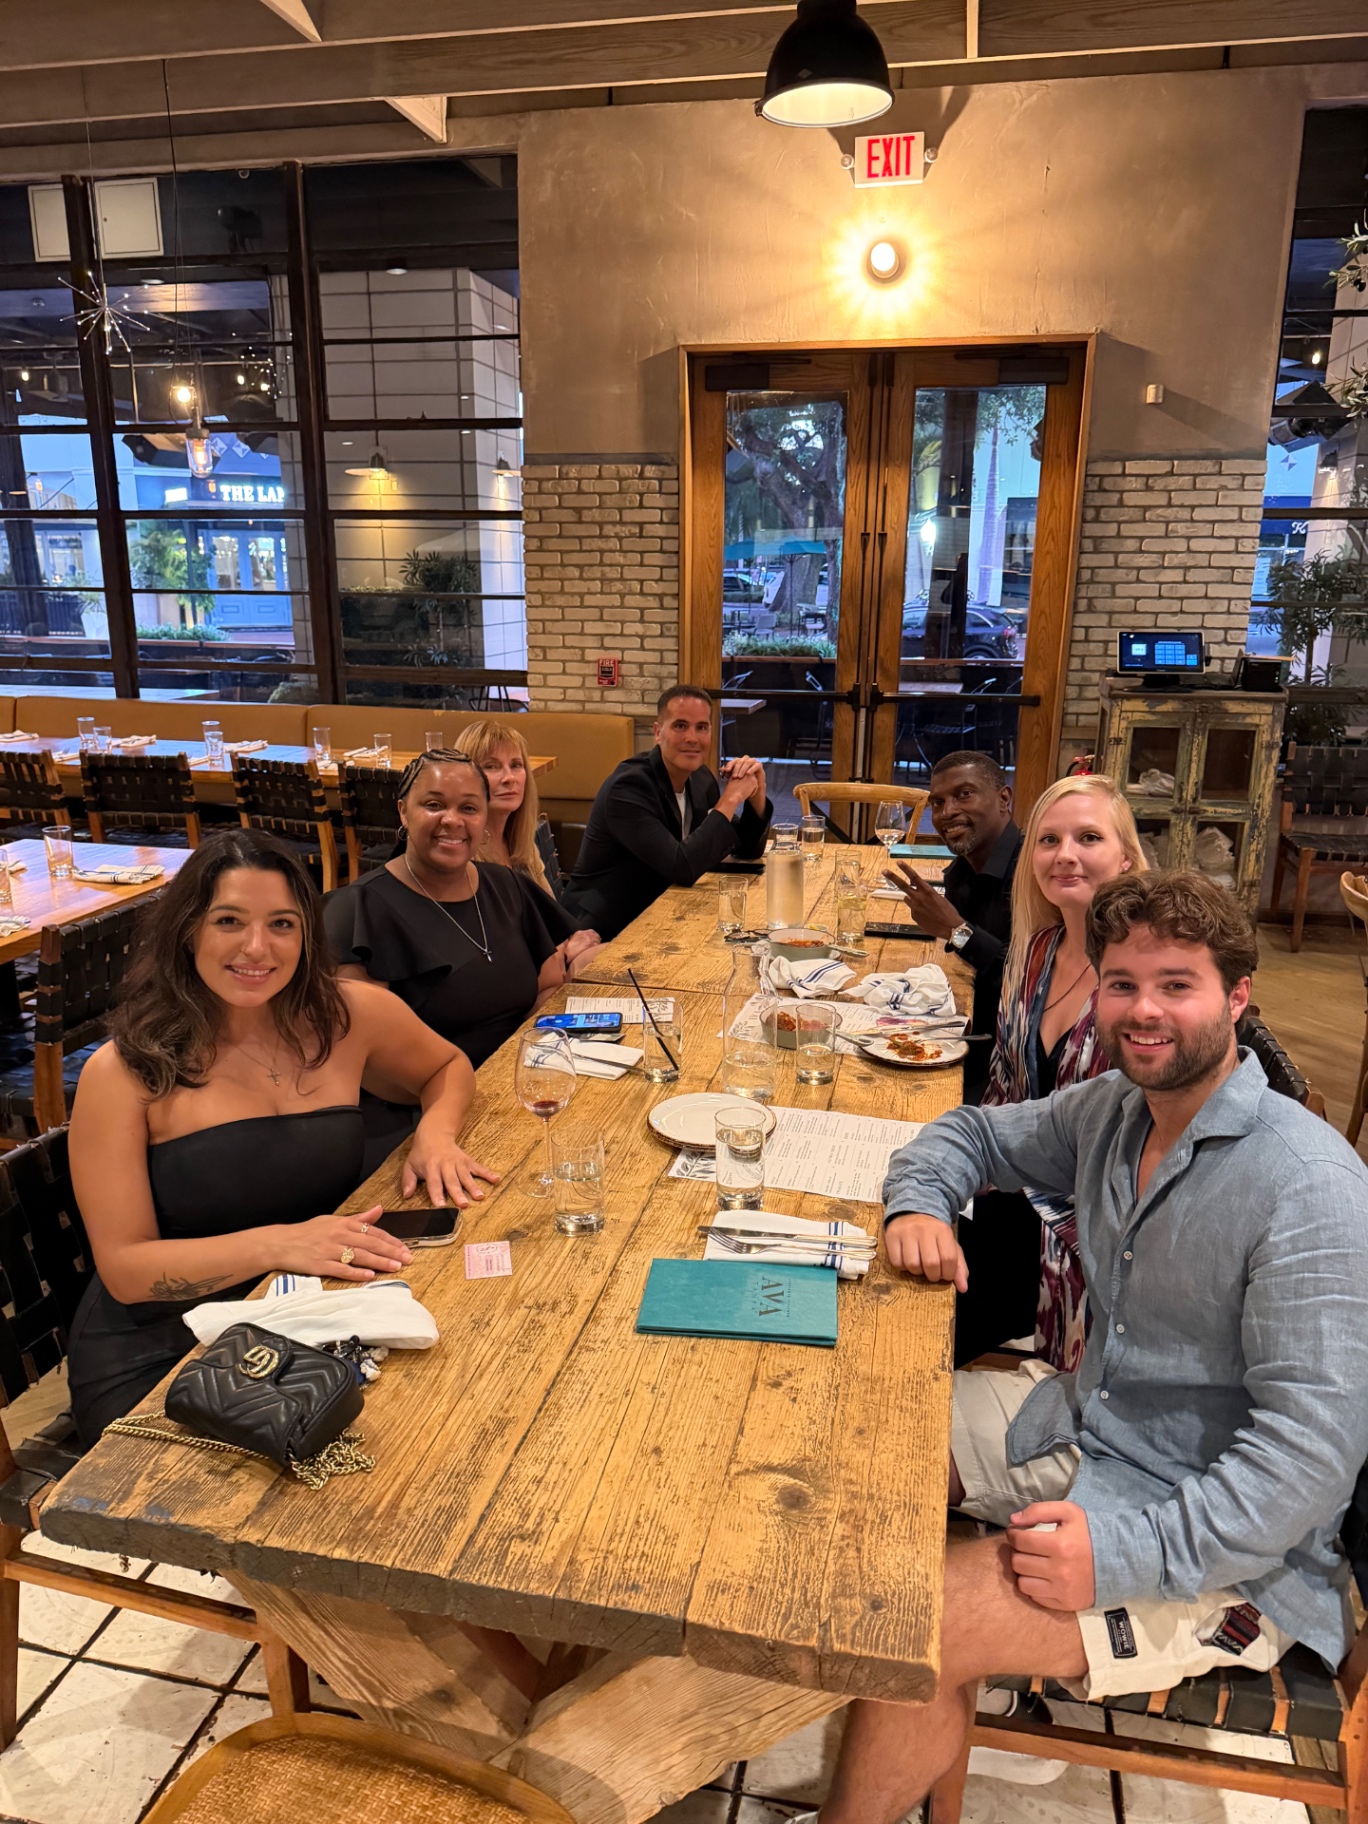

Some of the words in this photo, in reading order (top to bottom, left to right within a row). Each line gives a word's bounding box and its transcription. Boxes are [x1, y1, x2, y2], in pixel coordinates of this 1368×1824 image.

[867, 135, 915, 178] EXIT
[220, 484, 255, 502] THE
[758, 1276, 785, 1317] AVA
